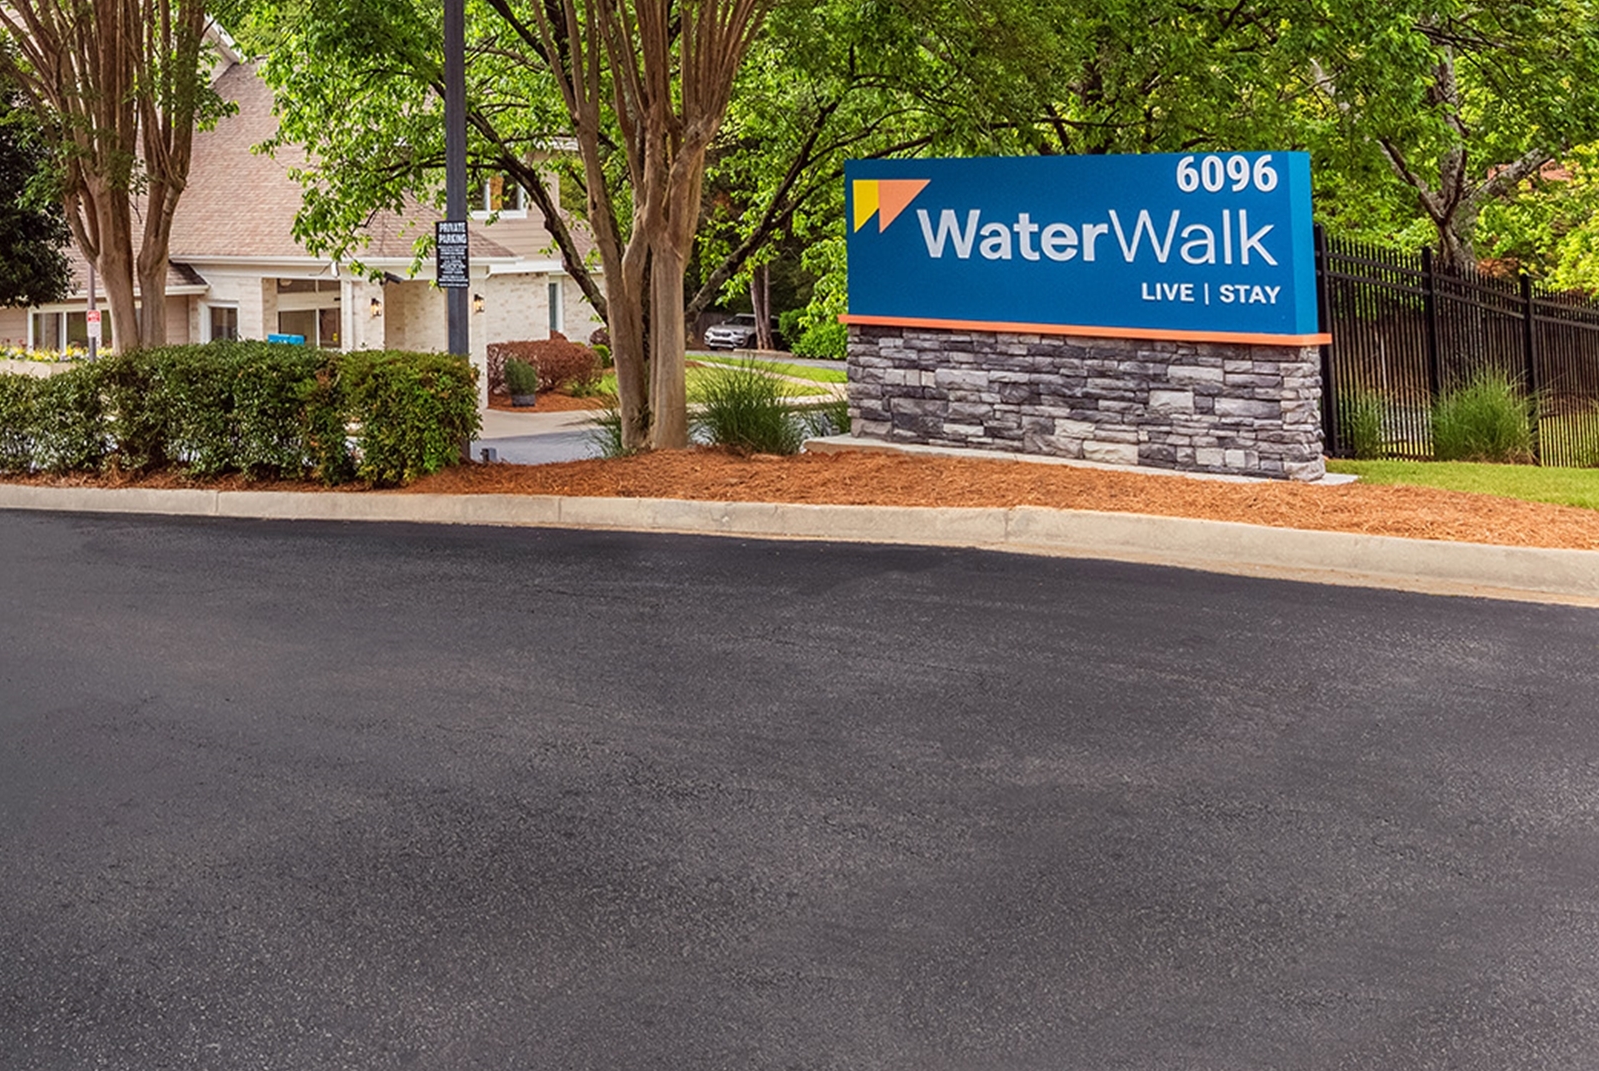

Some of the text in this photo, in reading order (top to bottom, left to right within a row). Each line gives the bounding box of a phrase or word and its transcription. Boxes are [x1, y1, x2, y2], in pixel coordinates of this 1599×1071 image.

[1176, 153, 1279, 193] 6096
[438, 222, 466, 233] PRIVATE
[438, 233, 468, 244] PARKING
[916, 209, 1279, 266] WaterWalk
[1141, 282, 1195, 302] LIVE
[1219, 284, 1281, 304] STAY
